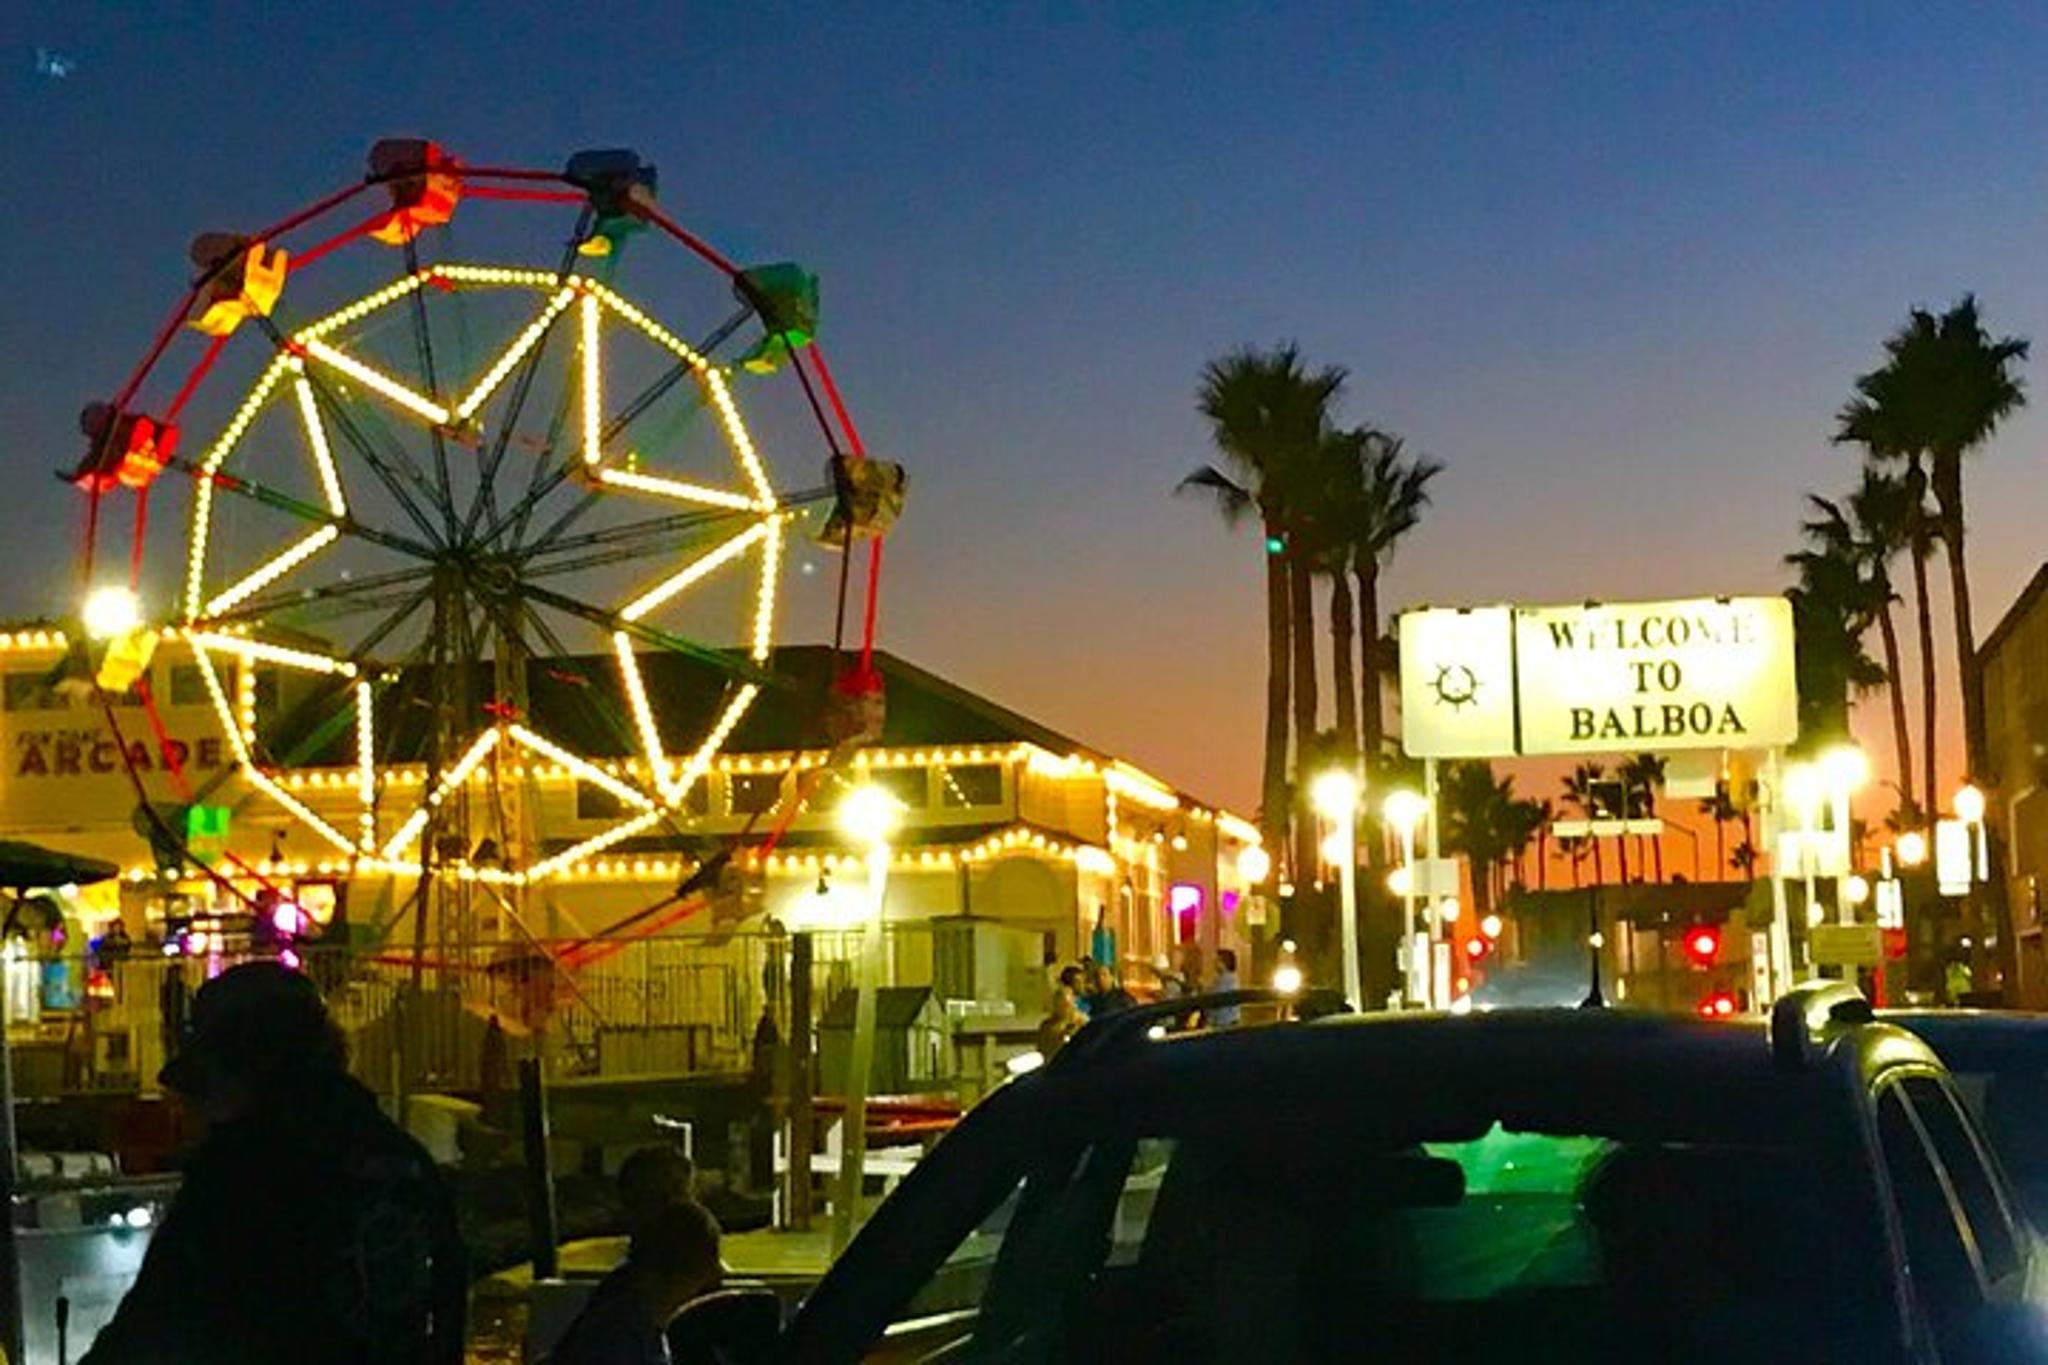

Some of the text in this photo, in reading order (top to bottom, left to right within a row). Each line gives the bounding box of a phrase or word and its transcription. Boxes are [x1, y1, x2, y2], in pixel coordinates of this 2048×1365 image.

[1630, 661, 1682, 693] TO
[1571, 703, 1746, 740] BALBOA
[19, 738, 221, 776] ARCADE
